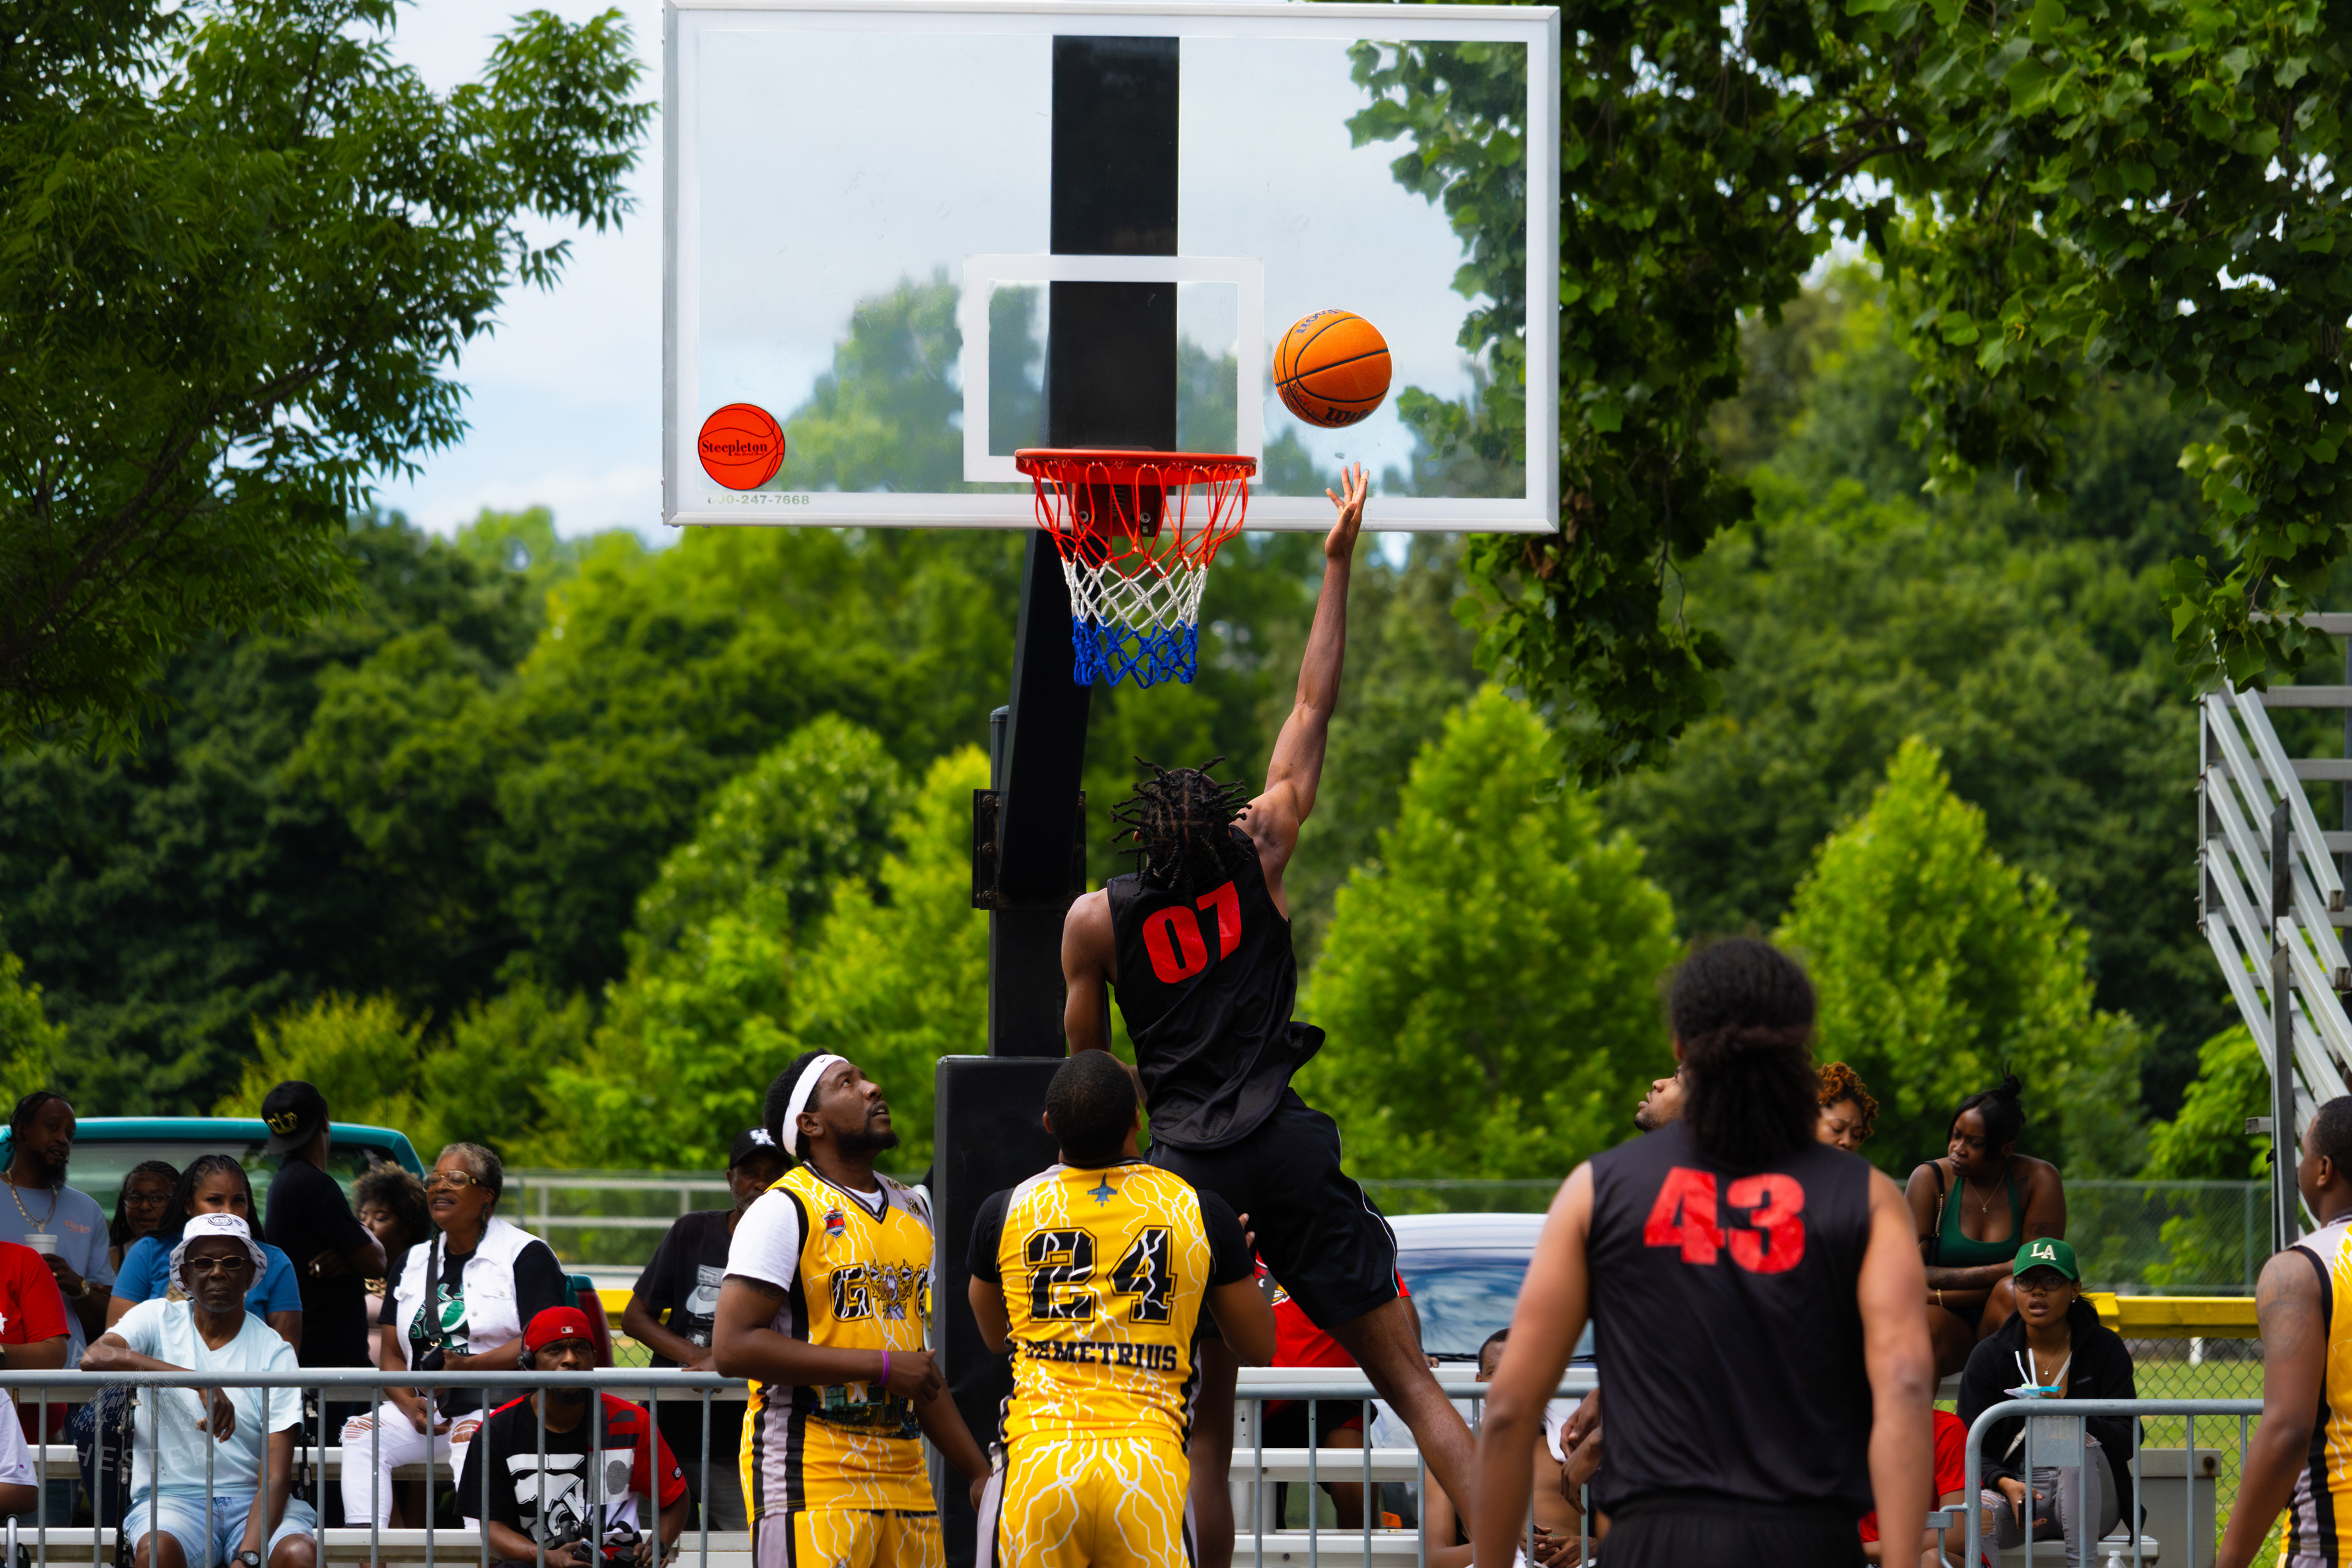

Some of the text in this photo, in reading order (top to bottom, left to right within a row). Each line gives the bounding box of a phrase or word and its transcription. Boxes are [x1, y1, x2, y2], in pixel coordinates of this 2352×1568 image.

[1324, 407, 1370, 423] Wil
[702, 439, 767, 456] Steepleton
[1142, 880, 1242, 984] 07
[1643, 1166, 1805, 1275] 43
[2030, 1243, 2057, 1261] LA
[1023, 1225, 1177, 1325] 24
[1025, 1340, 1177, 1371] DEMETRIUS
